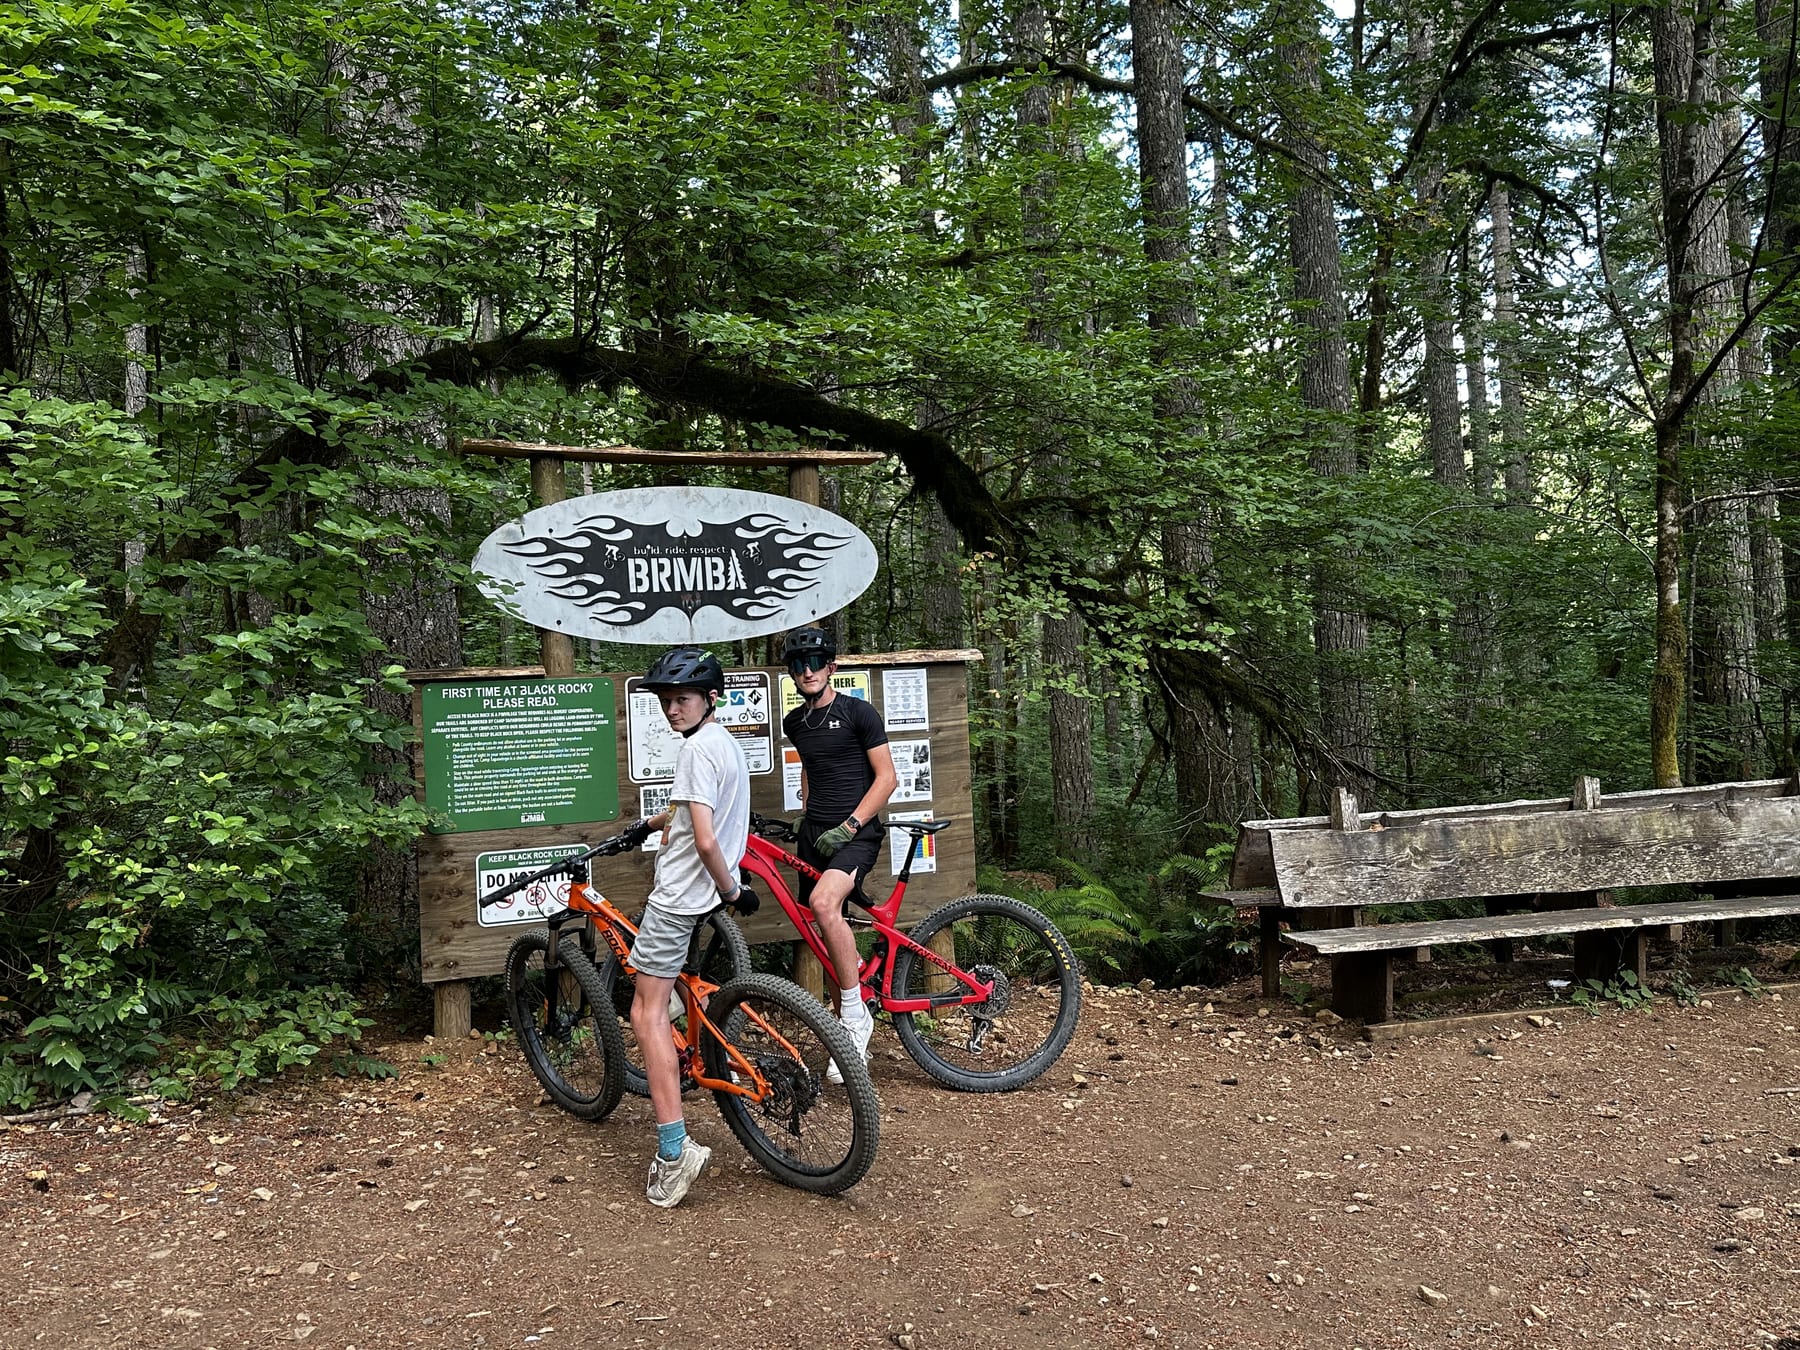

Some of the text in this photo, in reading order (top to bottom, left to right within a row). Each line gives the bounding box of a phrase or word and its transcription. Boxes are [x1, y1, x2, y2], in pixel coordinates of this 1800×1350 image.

[665, 546, 687, 555] ride.
[690, 546, 729, 556] respect.
[628, 549, 748, 593] BRMBA
[731, 674, 760, 683] TRAINING
[834, 677, 856, 688] HERE
[442, 682, 594, 699] FIRST TIME AT BLACK ROCK?
[483, 696, 560, 709] PLEASE READ.
[488, 849, 579, 863] KEEP BLACK ROCK CLEAN!
[486, 873, 505, 888] DO
[603, 929, 631, 969] ROCKY
[1044, 930, 1071, 970] MAXXIS
